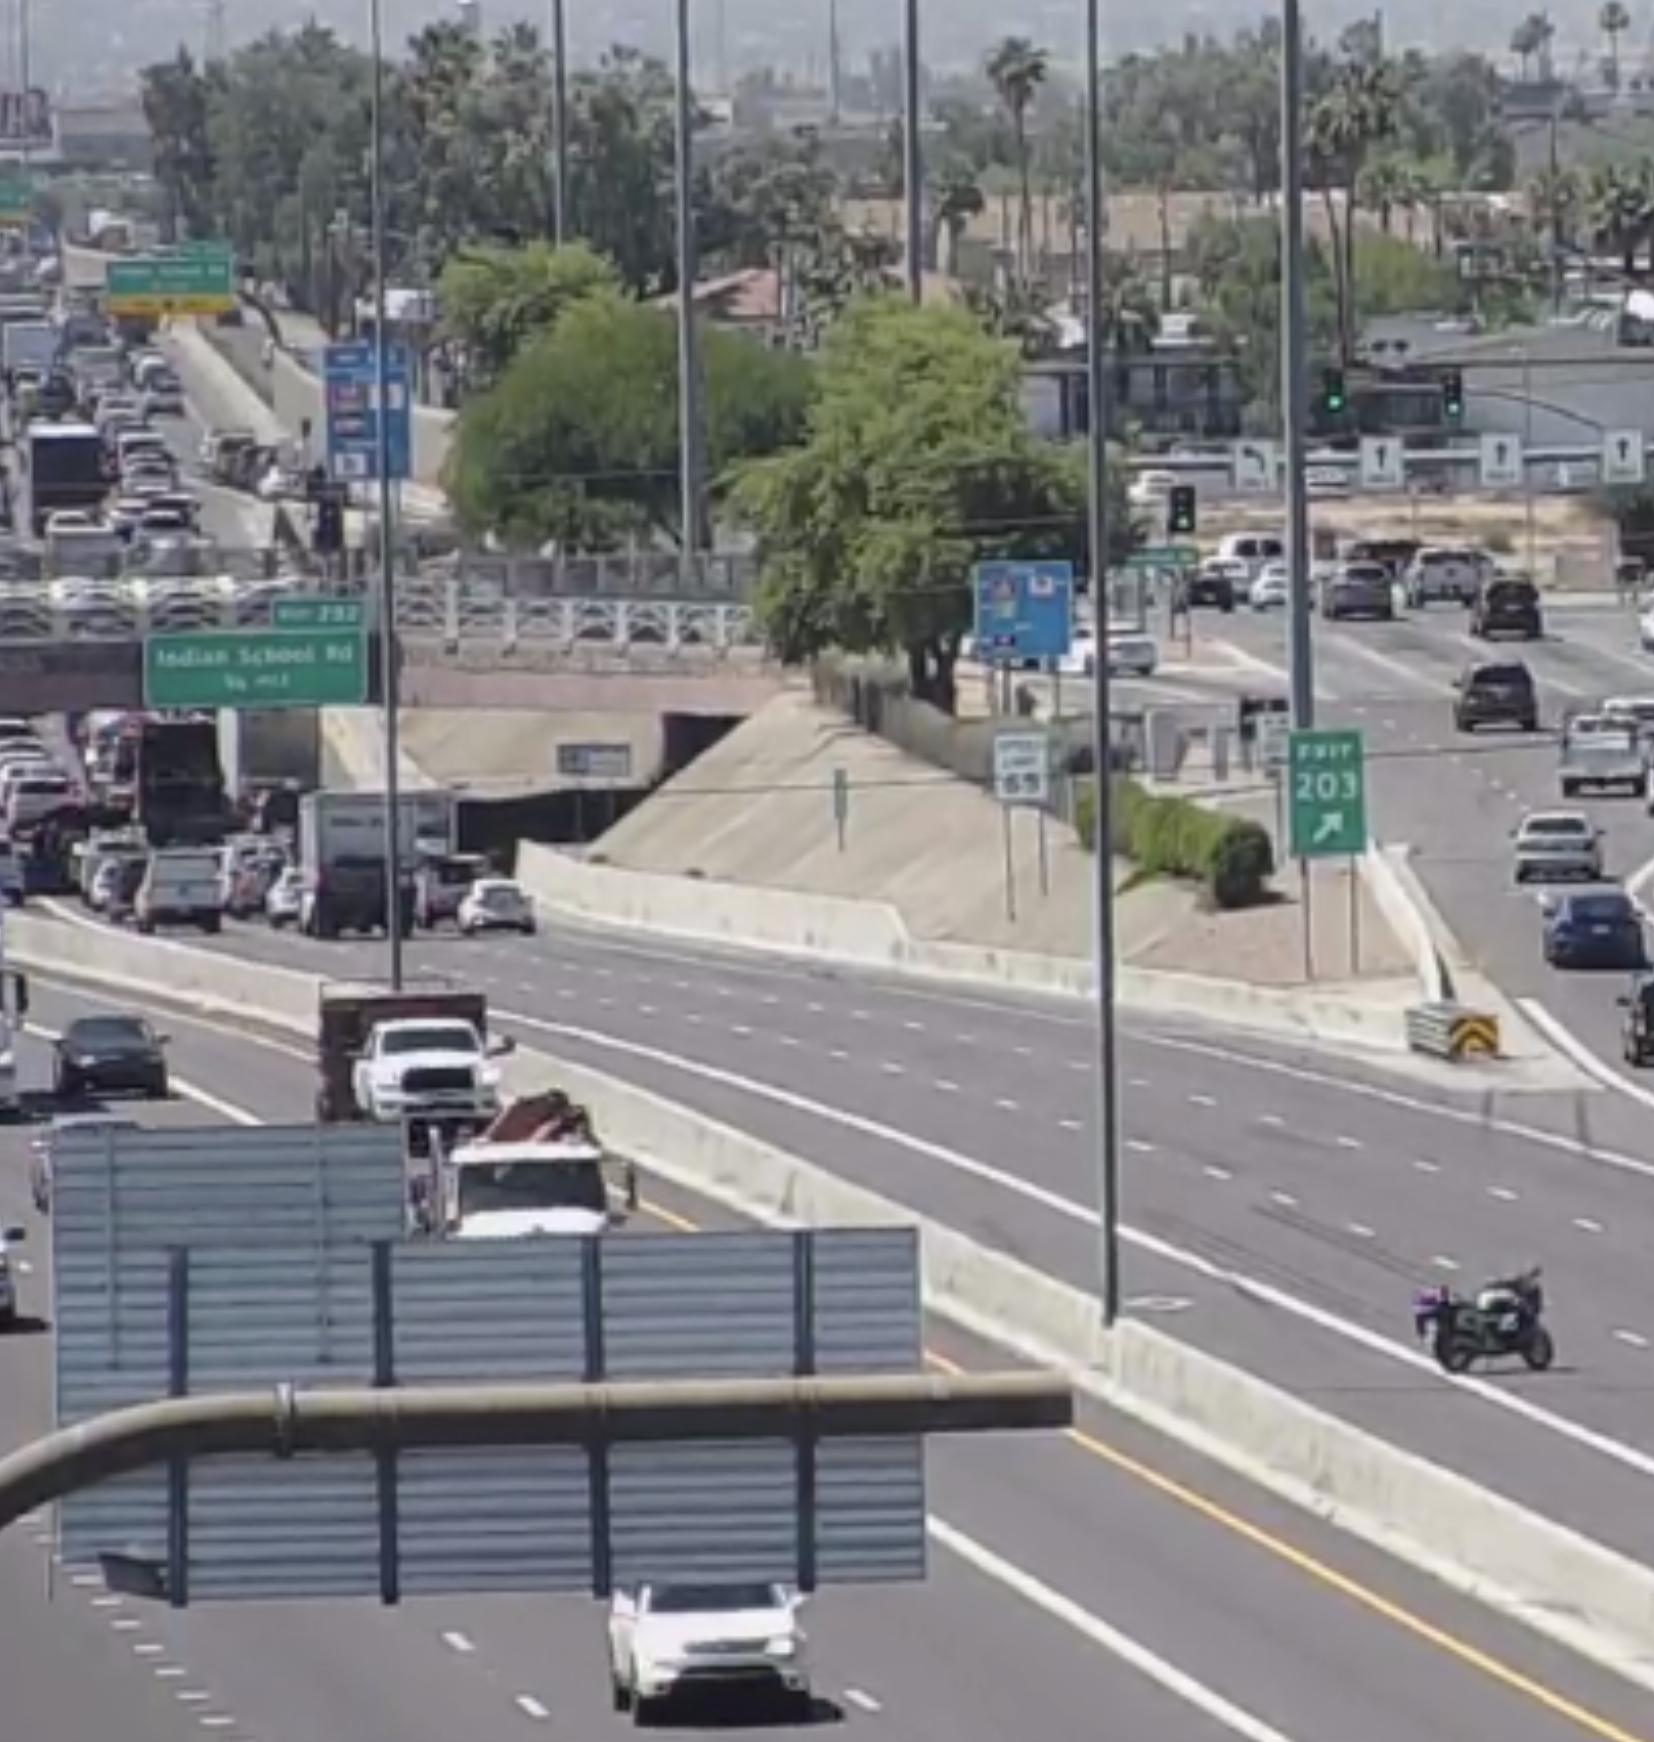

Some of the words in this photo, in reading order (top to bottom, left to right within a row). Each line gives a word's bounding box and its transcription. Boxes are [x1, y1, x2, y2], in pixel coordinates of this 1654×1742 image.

[156, 647, 230, 668] Indian
[239, 643, 316, 667] School
[325, 641, 353, 663] Rd
[1296, 772, 1358, 799] 203
